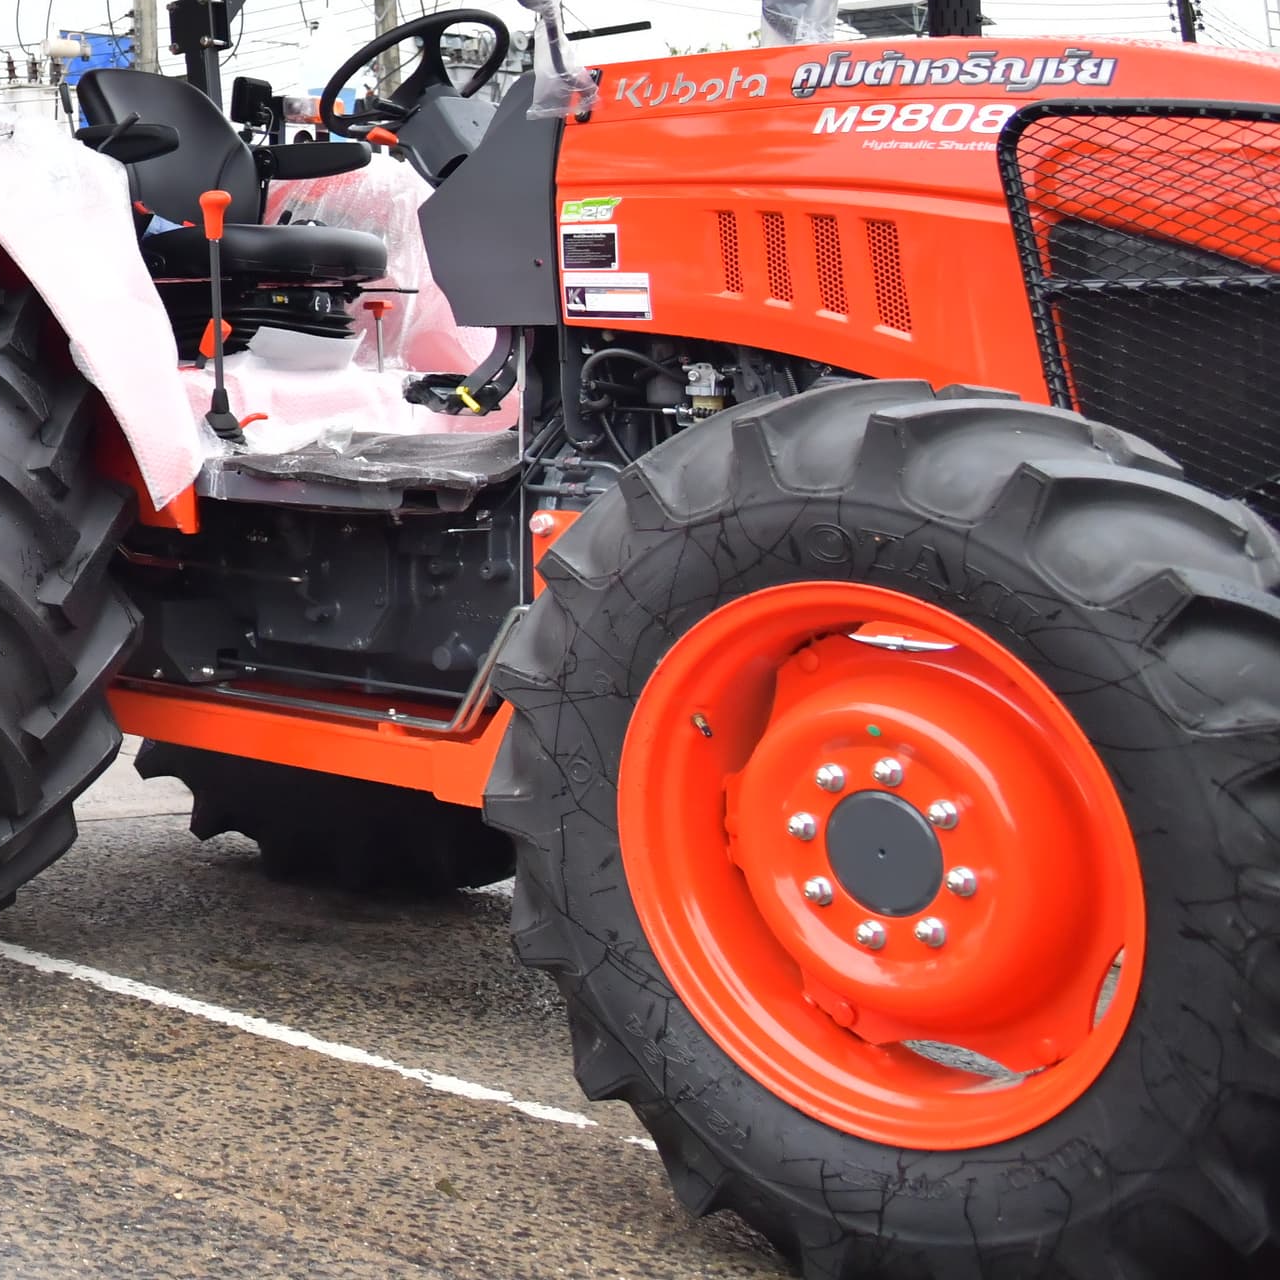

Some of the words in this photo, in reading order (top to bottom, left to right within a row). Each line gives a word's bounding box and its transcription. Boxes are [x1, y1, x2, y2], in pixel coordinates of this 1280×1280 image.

[615, 66, 768, 108] Kubota
[791, 49, 1118, 98] คูโบต้าเจริญชัย
[812, 103, 1017, 135] M9808
[861, 138, 936, 151] Hydraulic
